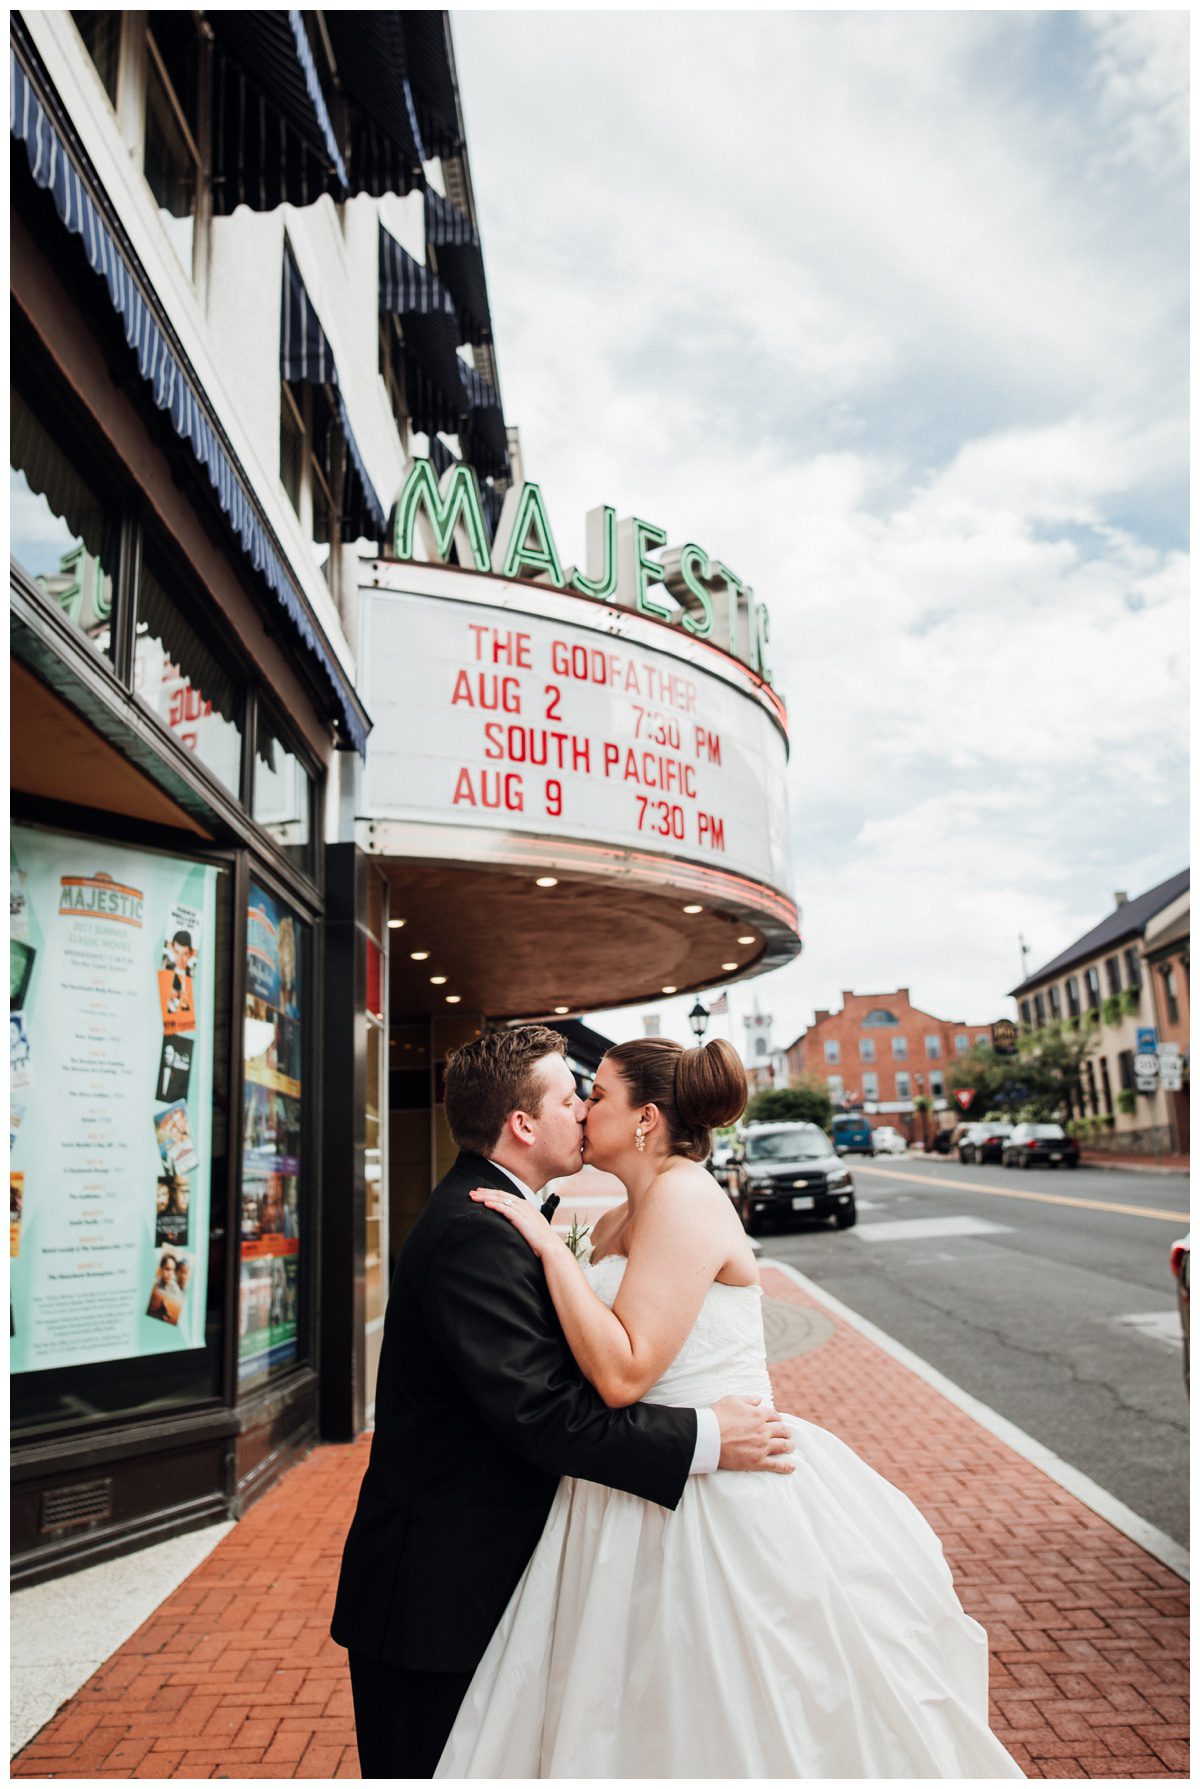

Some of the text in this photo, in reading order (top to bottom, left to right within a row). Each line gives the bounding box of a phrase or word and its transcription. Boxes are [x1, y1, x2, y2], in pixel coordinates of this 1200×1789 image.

[397, 457, 771, 686] MAJESTIC
[468, 624, 697, 714] THE GODFATHER
[451, 669, 722, 767] AUG 2 7:30 PM
[484, 721, 697, 799] SOUTH PACIFIC
[452, 767, 726, 852] AUG 9 7:30 PM
[60, 885, 144, 919] MAJESTIC
